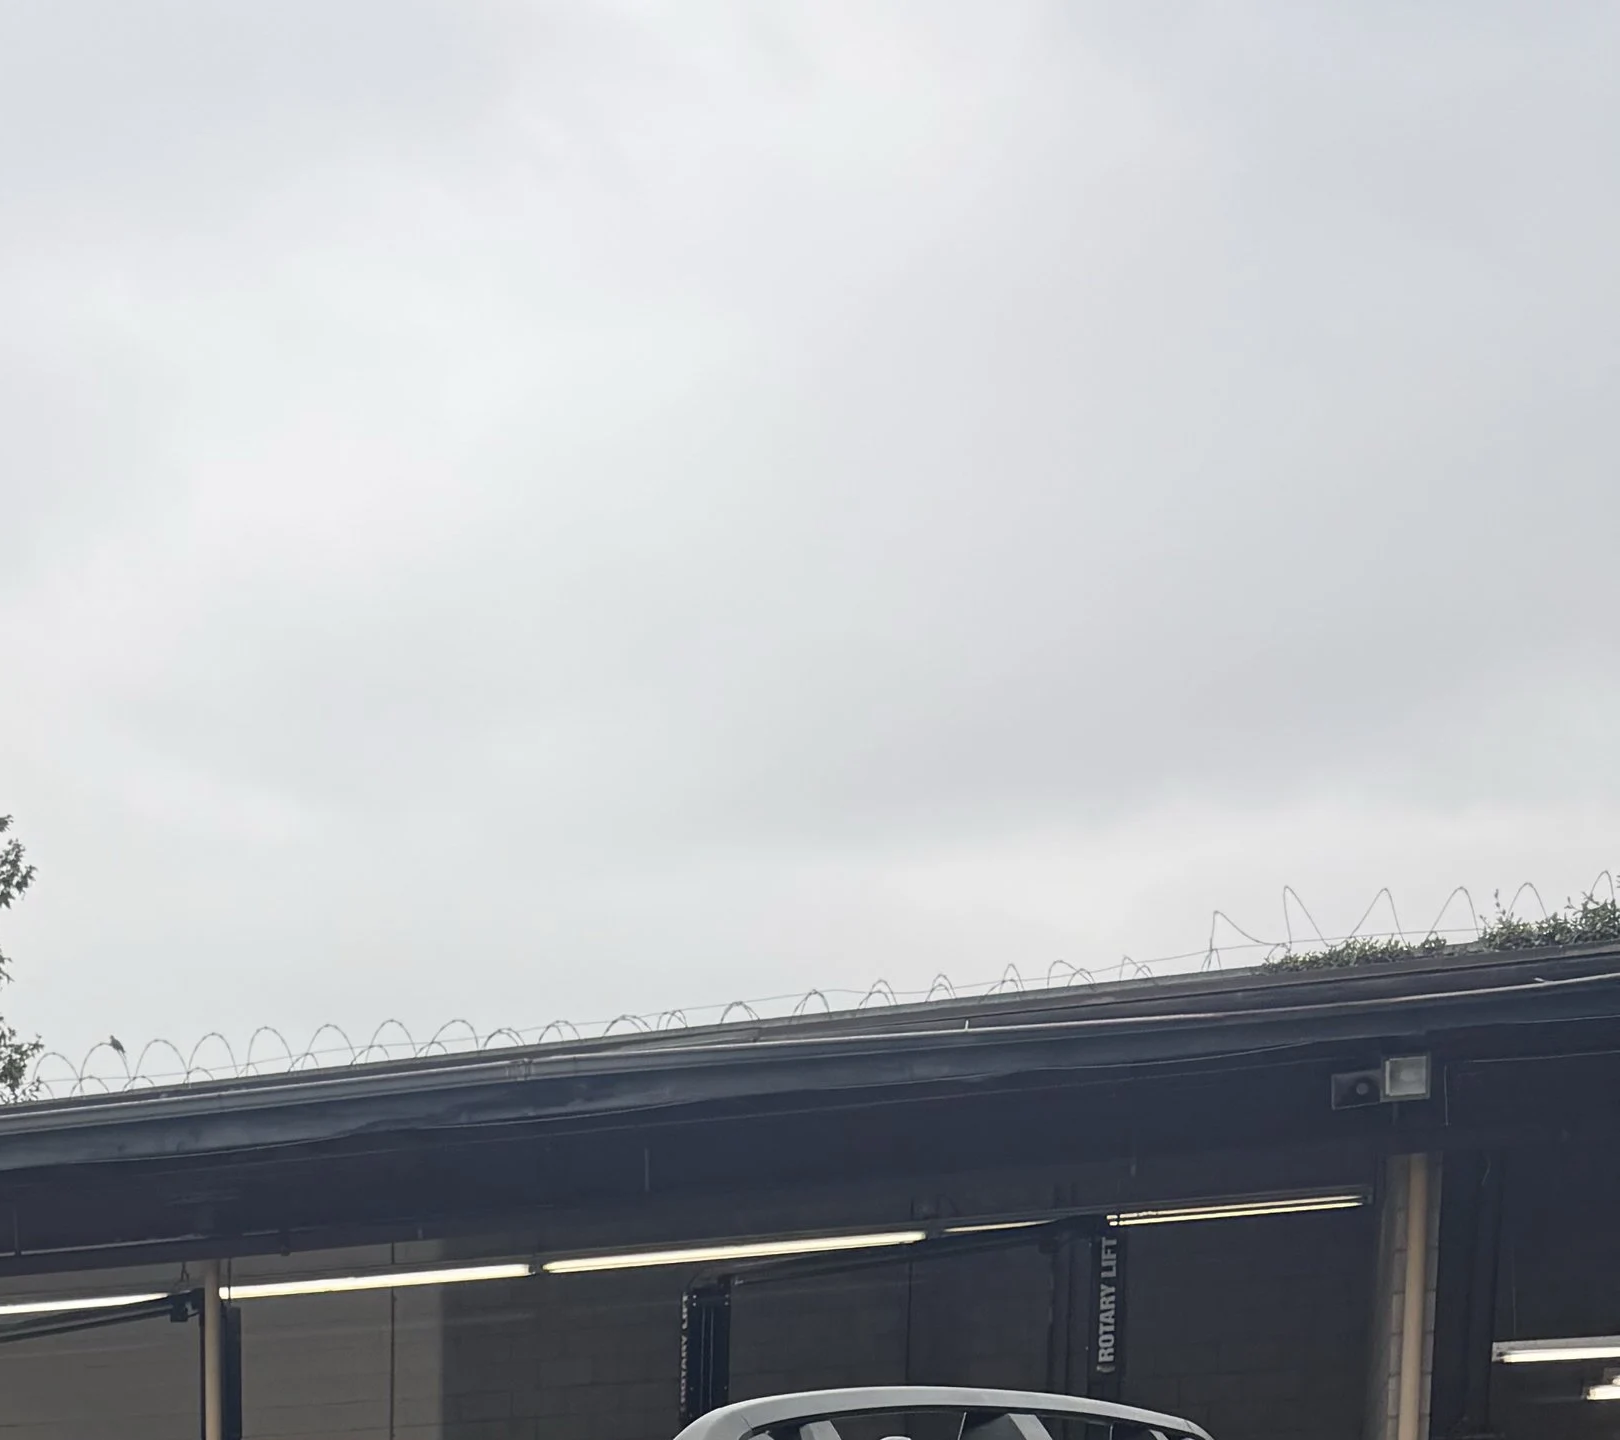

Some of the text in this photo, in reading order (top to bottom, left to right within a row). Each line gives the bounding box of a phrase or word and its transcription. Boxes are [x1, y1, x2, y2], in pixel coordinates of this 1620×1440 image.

[679, 1292, 690, 1405] ROTARY LIFT
[1097, 1236, 1117, 1362] ROTARY LIFT
